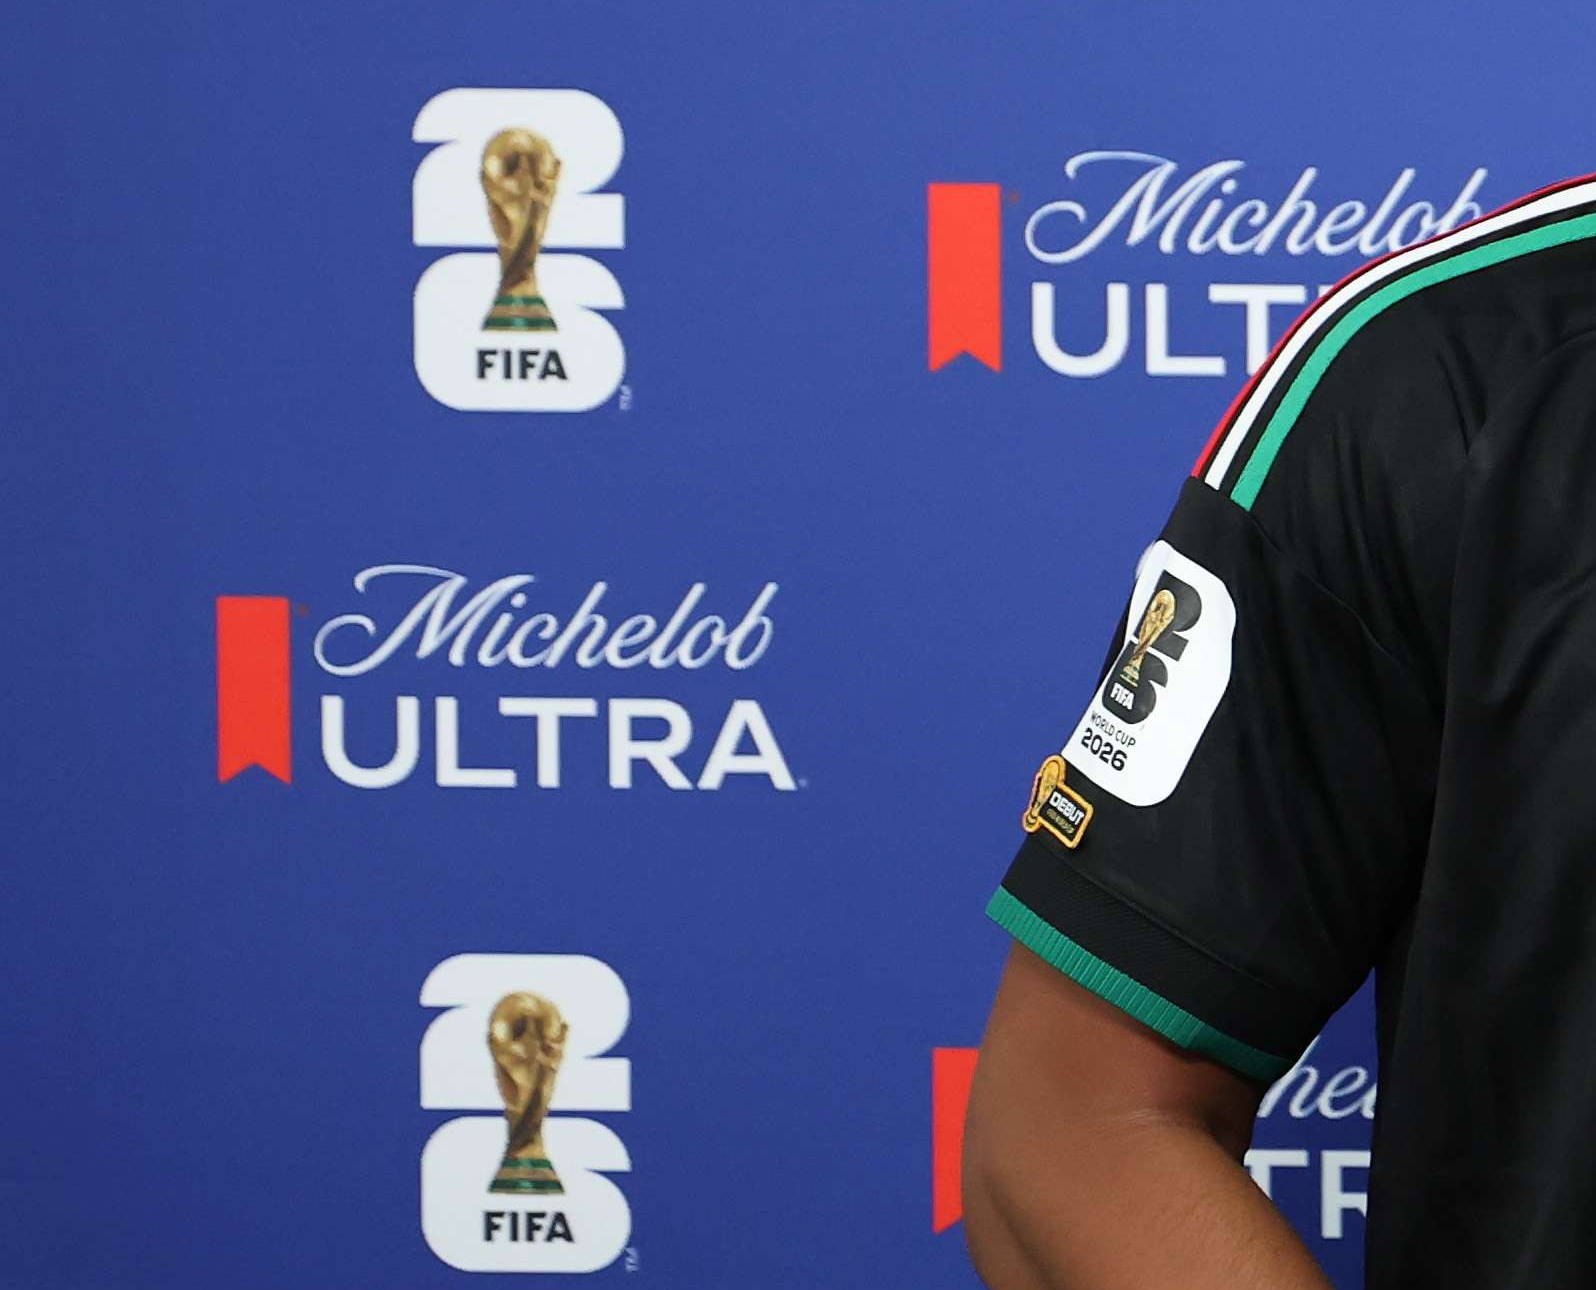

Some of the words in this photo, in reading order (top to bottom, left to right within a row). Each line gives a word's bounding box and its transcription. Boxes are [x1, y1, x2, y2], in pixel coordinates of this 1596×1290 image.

[1032, 282, 1337, 377] ULT
[477, 349, 568, 381] FIFA
[313, 564, 778, 676] Michelob
[1111, 683, 1135, 710] FIFA
[320, 694, 797, 791] ULTRA
[1090, 711, 1117, 737] WORLD
[1115, 729, 1136, 747] CUP
[1081, 728, 1128, 772] 2026
[1049, 791, 1085, 825] DEBUT
[484, 1211, 574, 1243] FIFA
